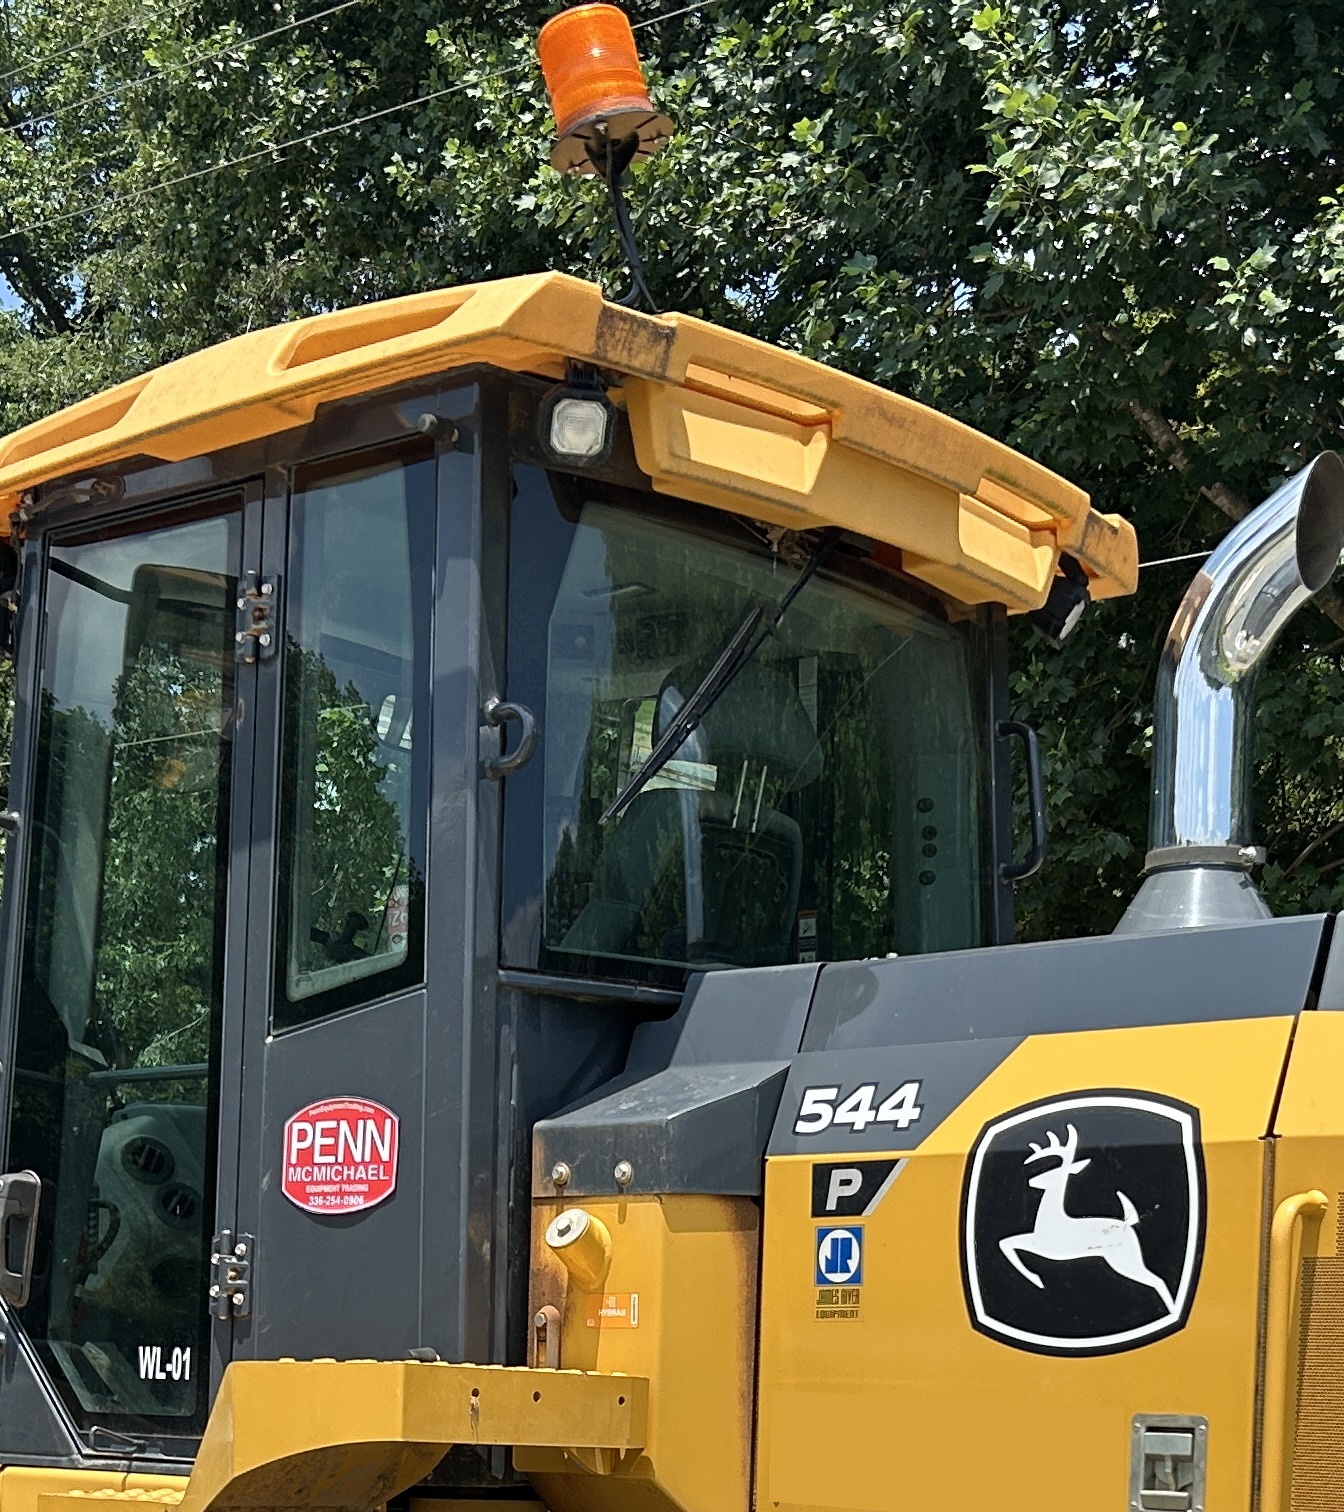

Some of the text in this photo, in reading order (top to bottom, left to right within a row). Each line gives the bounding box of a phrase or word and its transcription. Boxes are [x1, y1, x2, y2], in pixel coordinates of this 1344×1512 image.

[793, 1081, 923, 1134] 544
[290, 1118, 392, 1164] PENN
[288, 1164, 390, 1183] MCMICHAEL
[825, 1168, 863, 1211] P
[138, 1345, 191, 1381] WL-01
